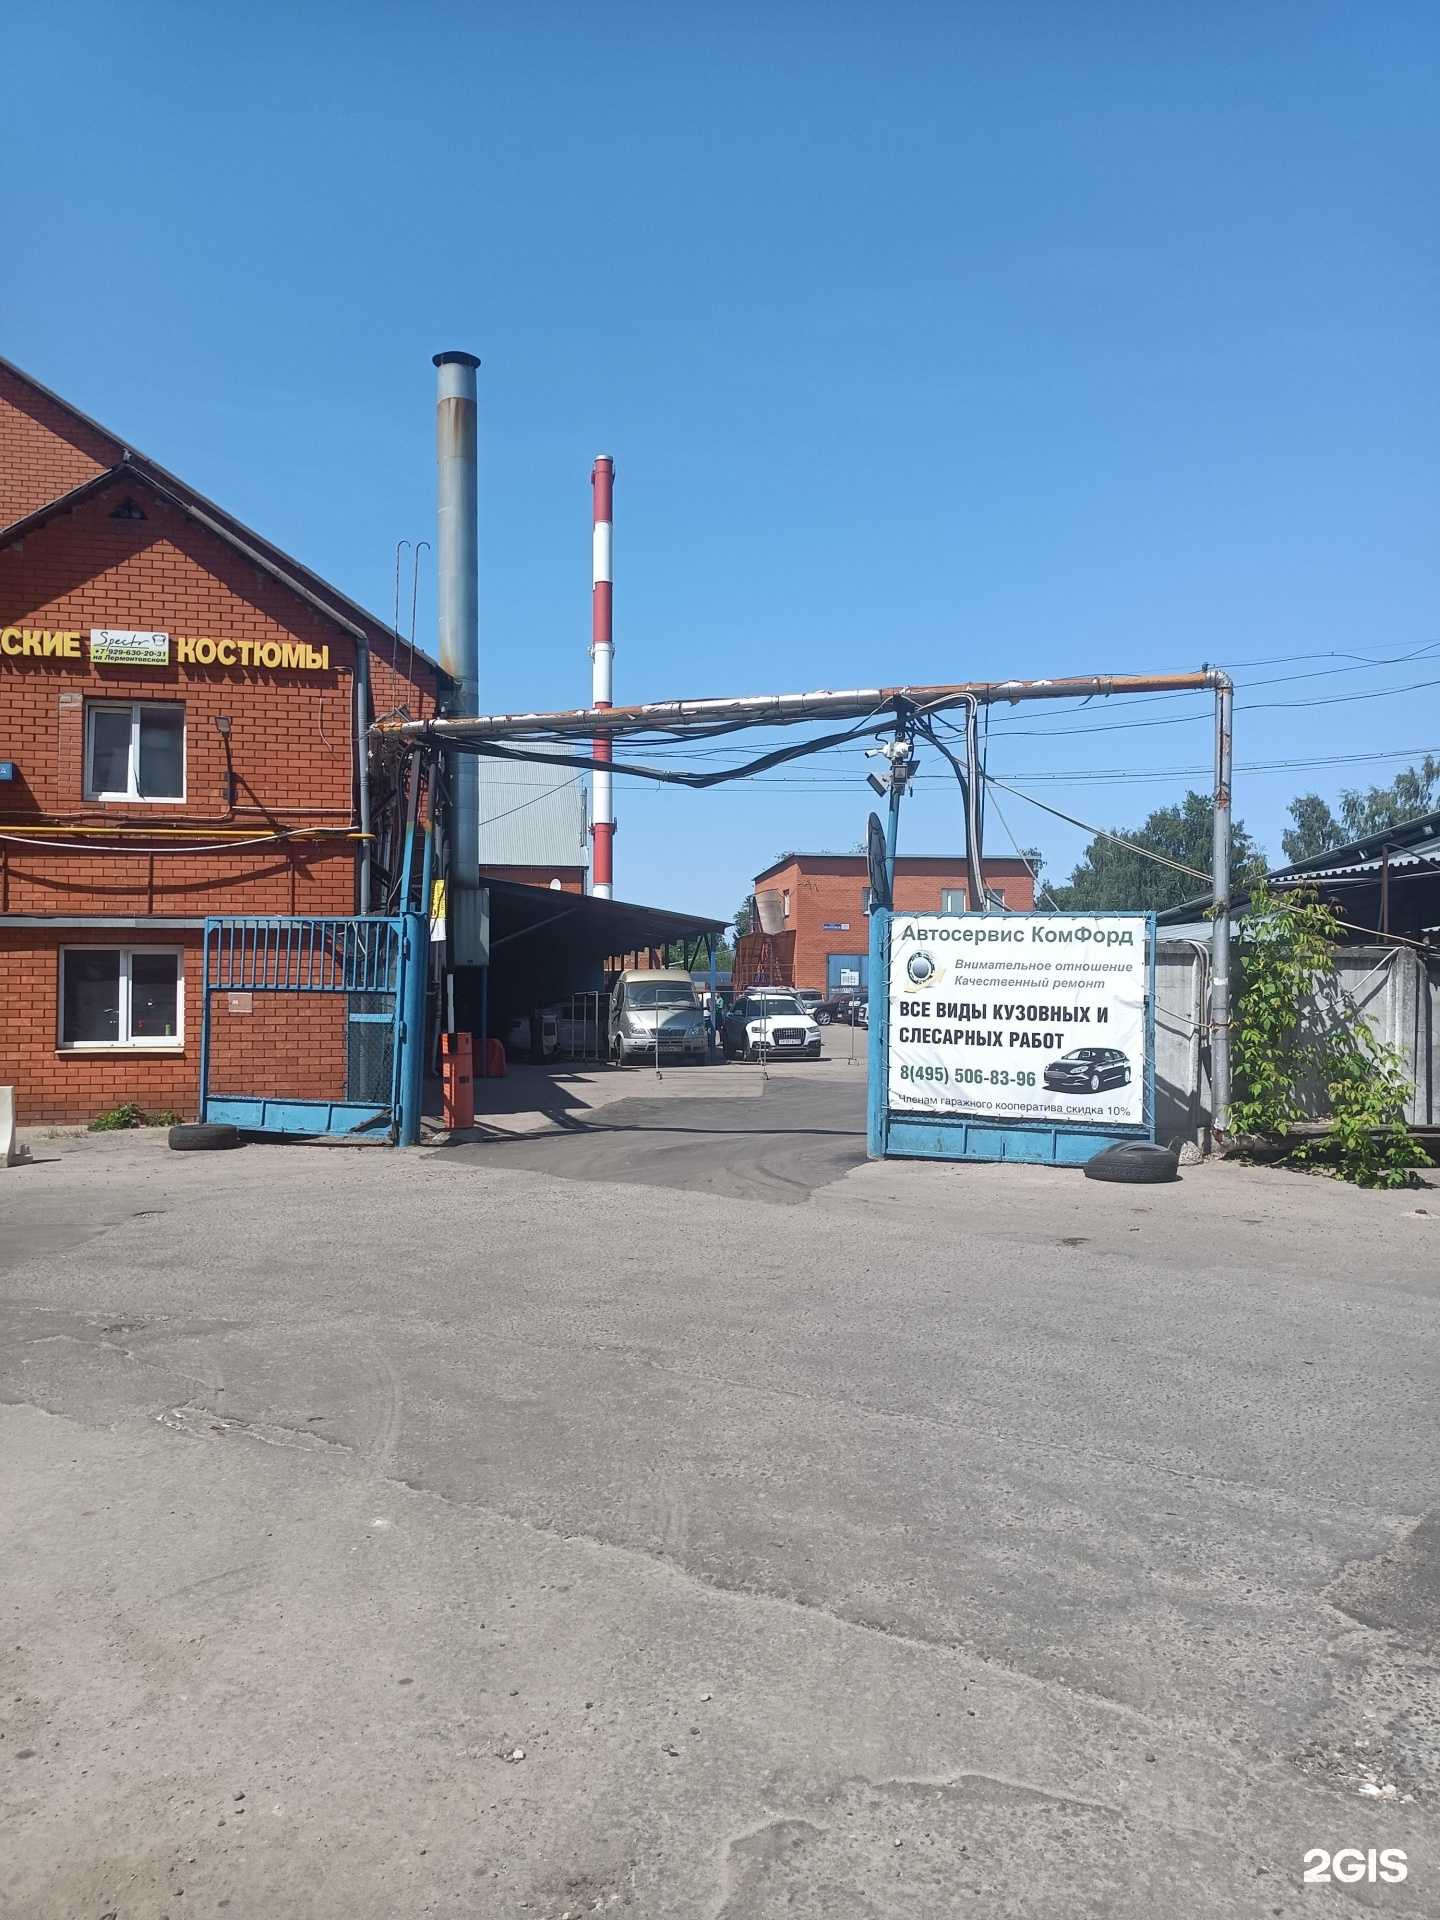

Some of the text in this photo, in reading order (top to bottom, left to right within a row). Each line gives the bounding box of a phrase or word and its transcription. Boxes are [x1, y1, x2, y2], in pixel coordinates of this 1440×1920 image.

[0, 628, 81, 657] СКИЕ
[177, 637, 329, 670] КОСТЮМЫ
[901, 925, 1134, 947] Автосервис КомФорд
[954, 959, 1133, 973] Внимательное отношение
[954, 975, 1105, 990] Качественный ремонт
[900, 1001, 1109, 1023] ВСЕ ВИДЫ КУЗОВНЫХ И
[899, 1027, 1064, 1049] СЛЕСАРНЫХ РАБОТ
[900, 1065, 1036, 1087] 8(495) 506-83-96
[898, 1093, 1131, 1117] Членам гаражного кооператива скидка 10%
